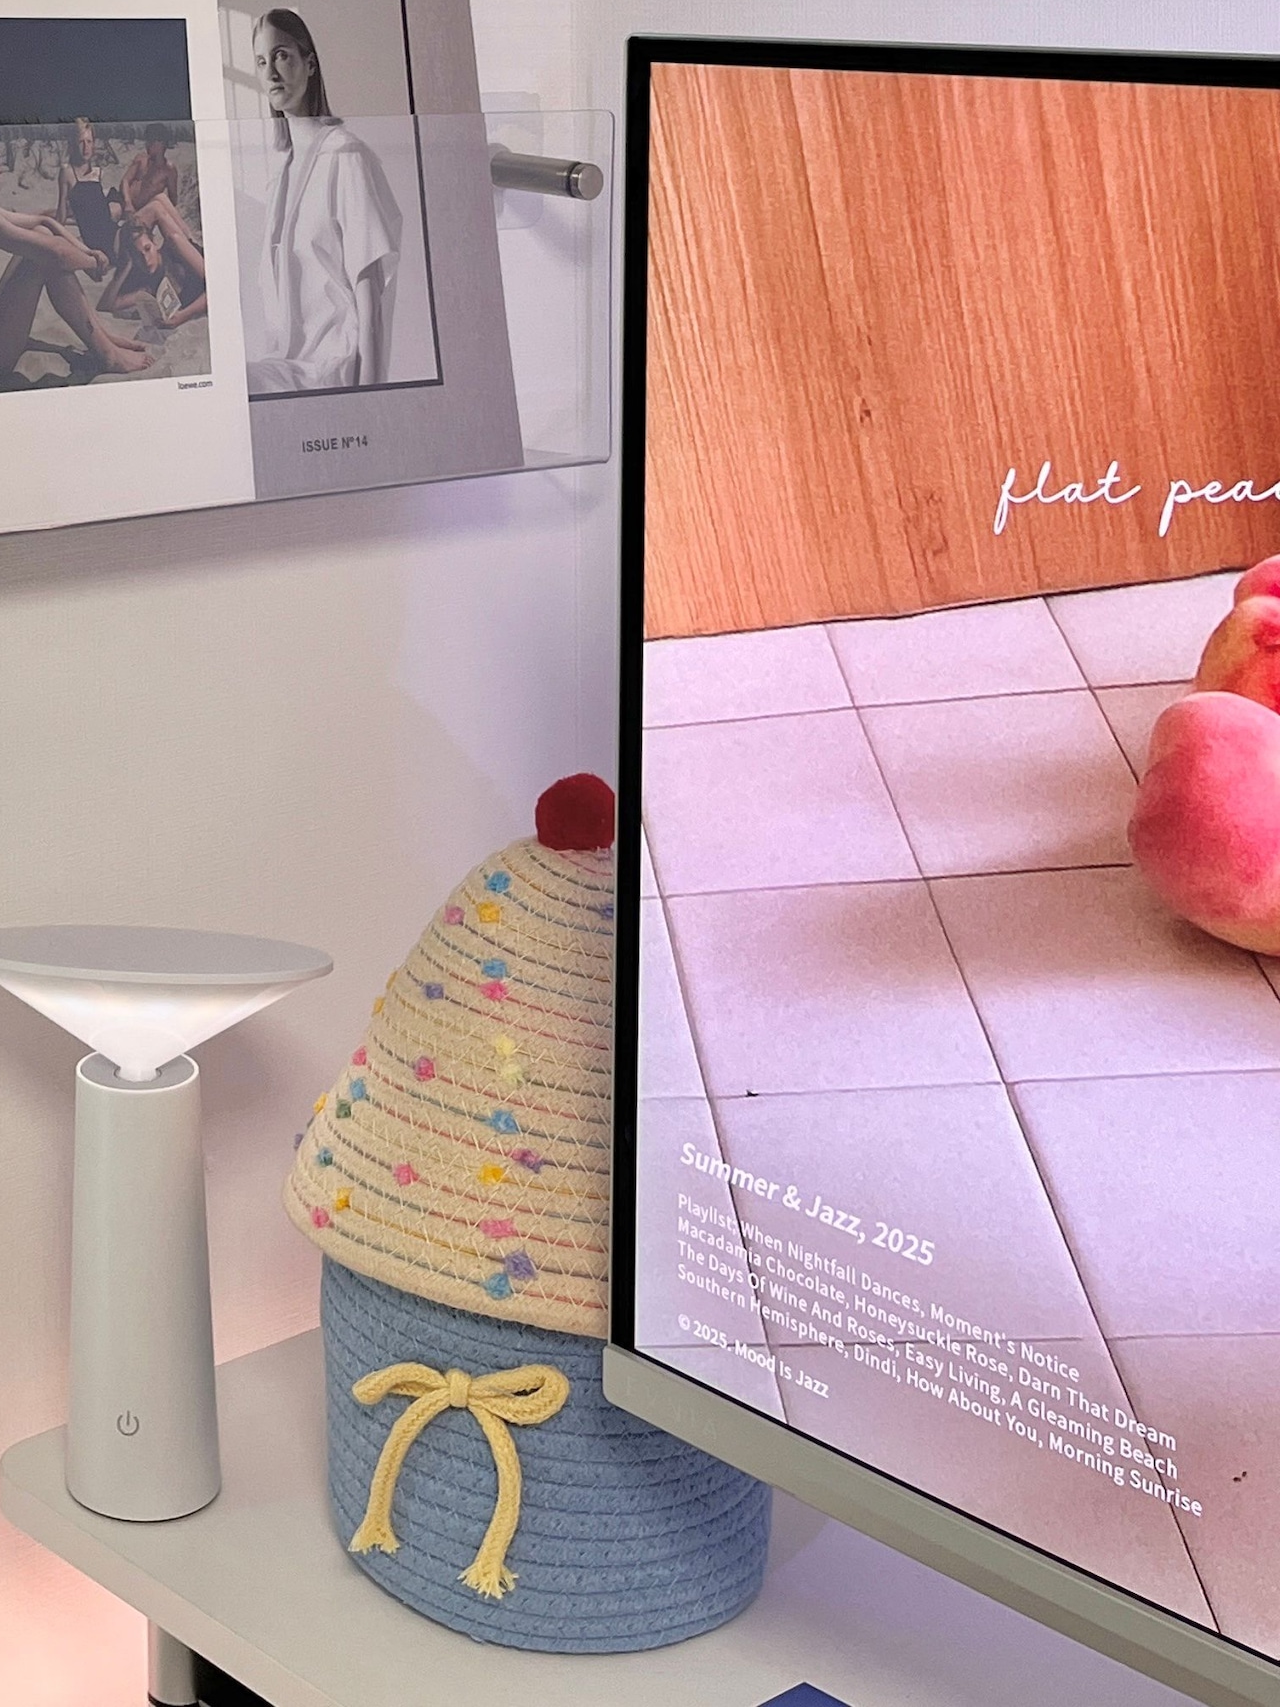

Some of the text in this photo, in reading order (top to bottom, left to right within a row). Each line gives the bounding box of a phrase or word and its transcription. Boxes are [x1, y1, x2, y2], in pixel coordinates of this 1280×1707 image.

[302, 437, 338, 453] ISSUE
[993, 460, 1142, 536] flat
[679, 1142, 936, 1266] Summer & Jazz, 2025
[677, 1216, 1177, 1452] Macadamia Chocolate, Honeysuckle Rose, Darn That Dream
[677, 1239, 1178, 1481] The Days Of Wine And Roses, Easy Living, A Gleaming Beach
[692, 1320, 732, 1353] 2025.
[735, 1339, 776, 1373] Mood
[795, 1370, 830, 1399] Jazz
[741, 1220, 783, 1253] When
[788, 1240, 857, 1285] Nightfall
[861, 1272, 925, 1319] Dances,
[930, 1303, 1016, 1355] Moment's
[1021, 1342, 1081, 1383] Notice
[677, 1263, 1203, 1518] Southern Hemisphere, Dindi, How About You, Morning Sunrise
